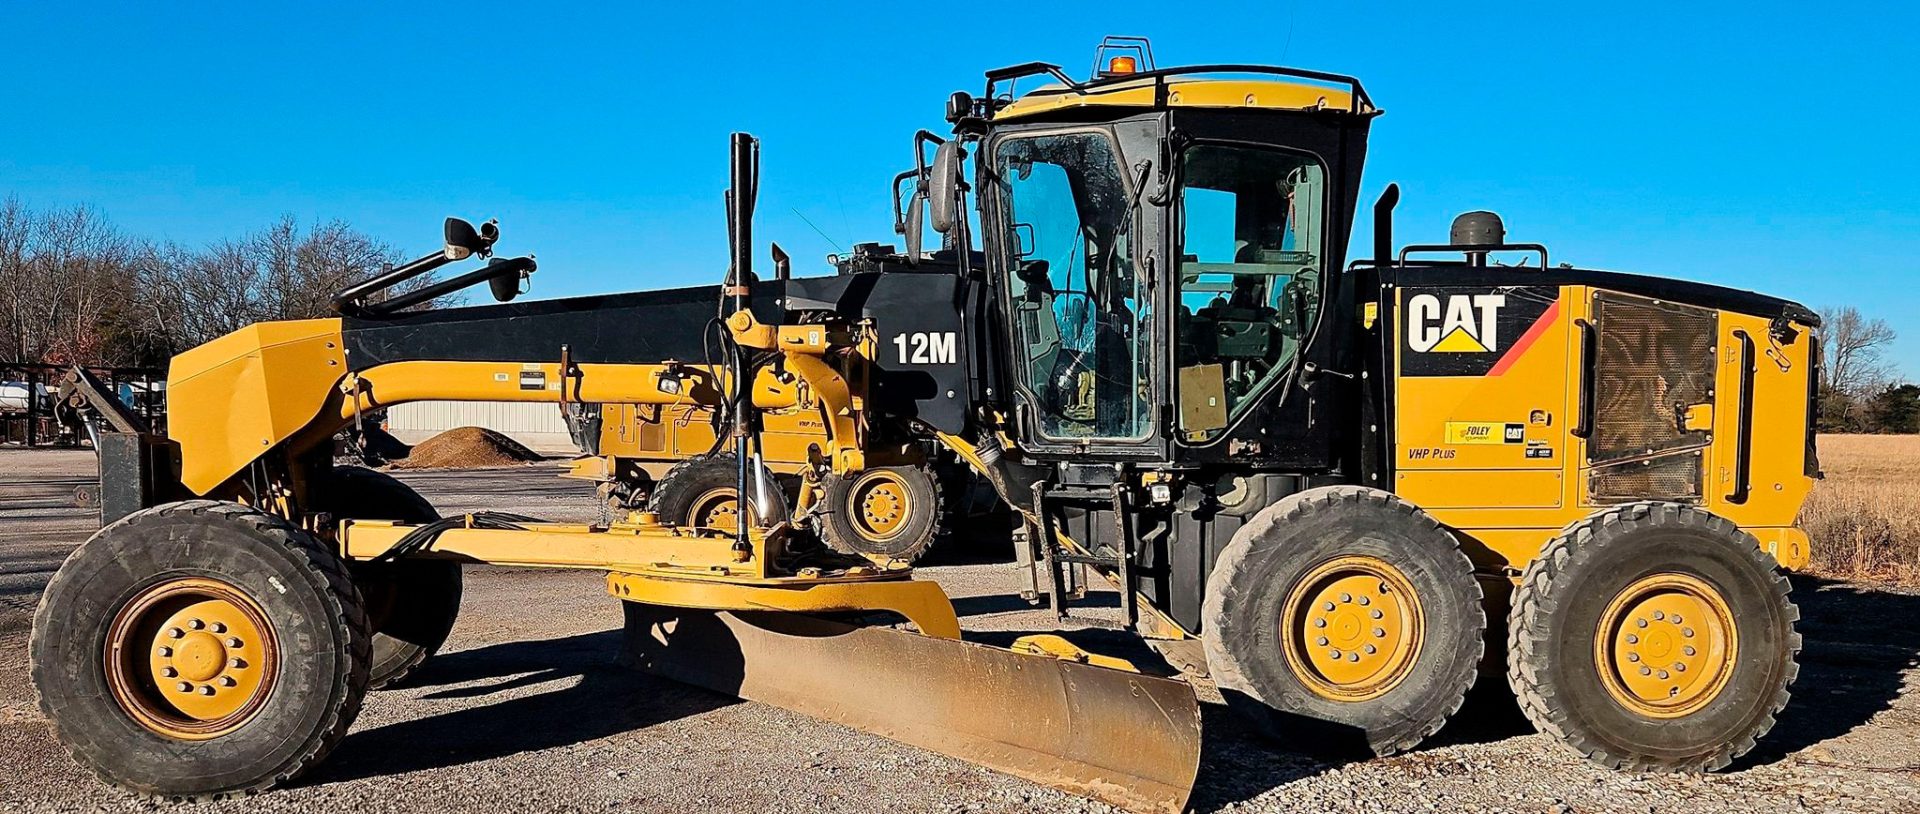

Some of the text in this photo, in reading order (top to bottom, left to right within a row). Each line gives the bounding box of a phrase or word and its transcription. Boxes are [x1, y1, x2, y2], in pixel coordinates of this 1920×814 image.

[1408, 294, 1505, 353] CAT
[893, 332, 956, 364] 12M
[1466, 426, 1491, 436] FOLEY
[1506, 428, 1524, 439] CAT
[1408, 448, 1430, 459] VHP
